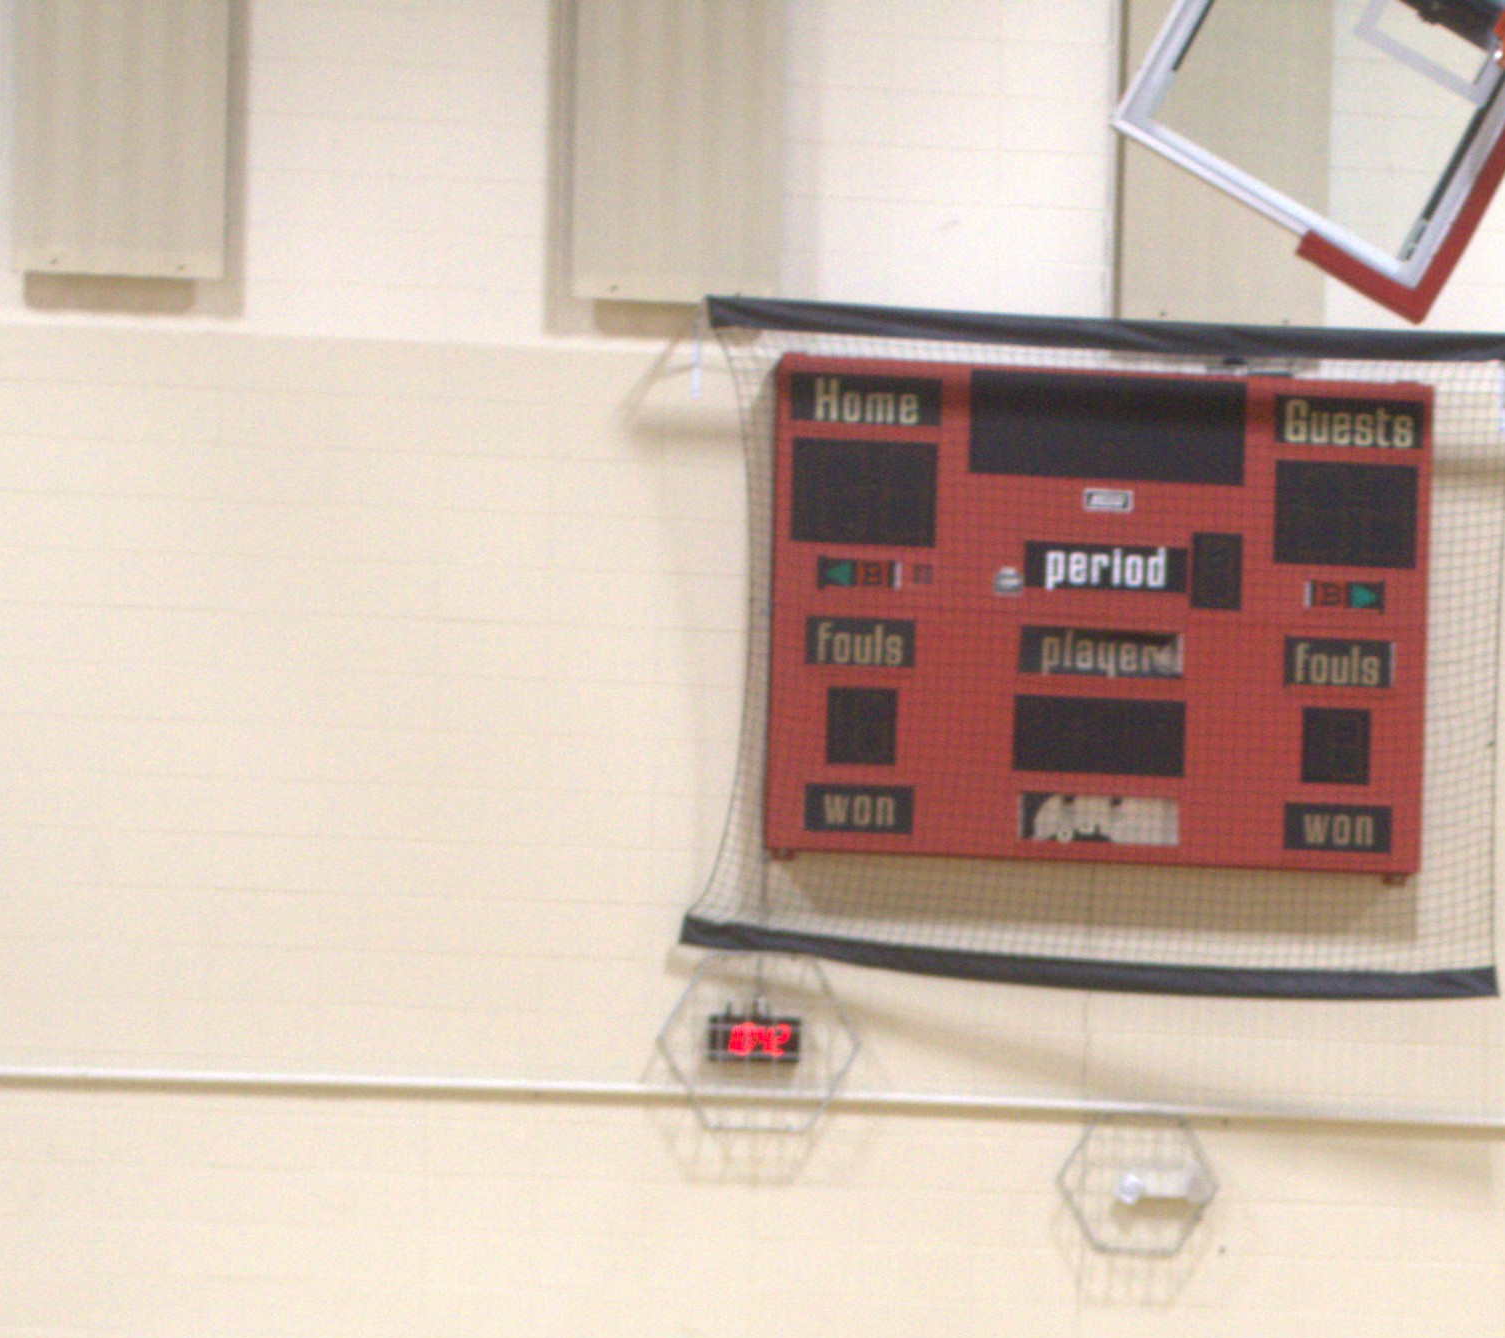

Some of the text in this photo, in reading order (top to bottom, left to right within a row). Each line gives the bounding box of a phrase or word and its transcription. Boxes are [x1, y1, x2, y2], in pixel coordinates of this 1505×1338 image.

[814, 376, 919, 425] Home
[1284, 399, 1415, 449] Guests
[1045, 546, 1168, 591] period
[817, 621, 904, 666] fouls
[1295, 643, 1380, 686] fouls
[824, 793, 895, 827] won
[1303, 811, 1374, 845] won
